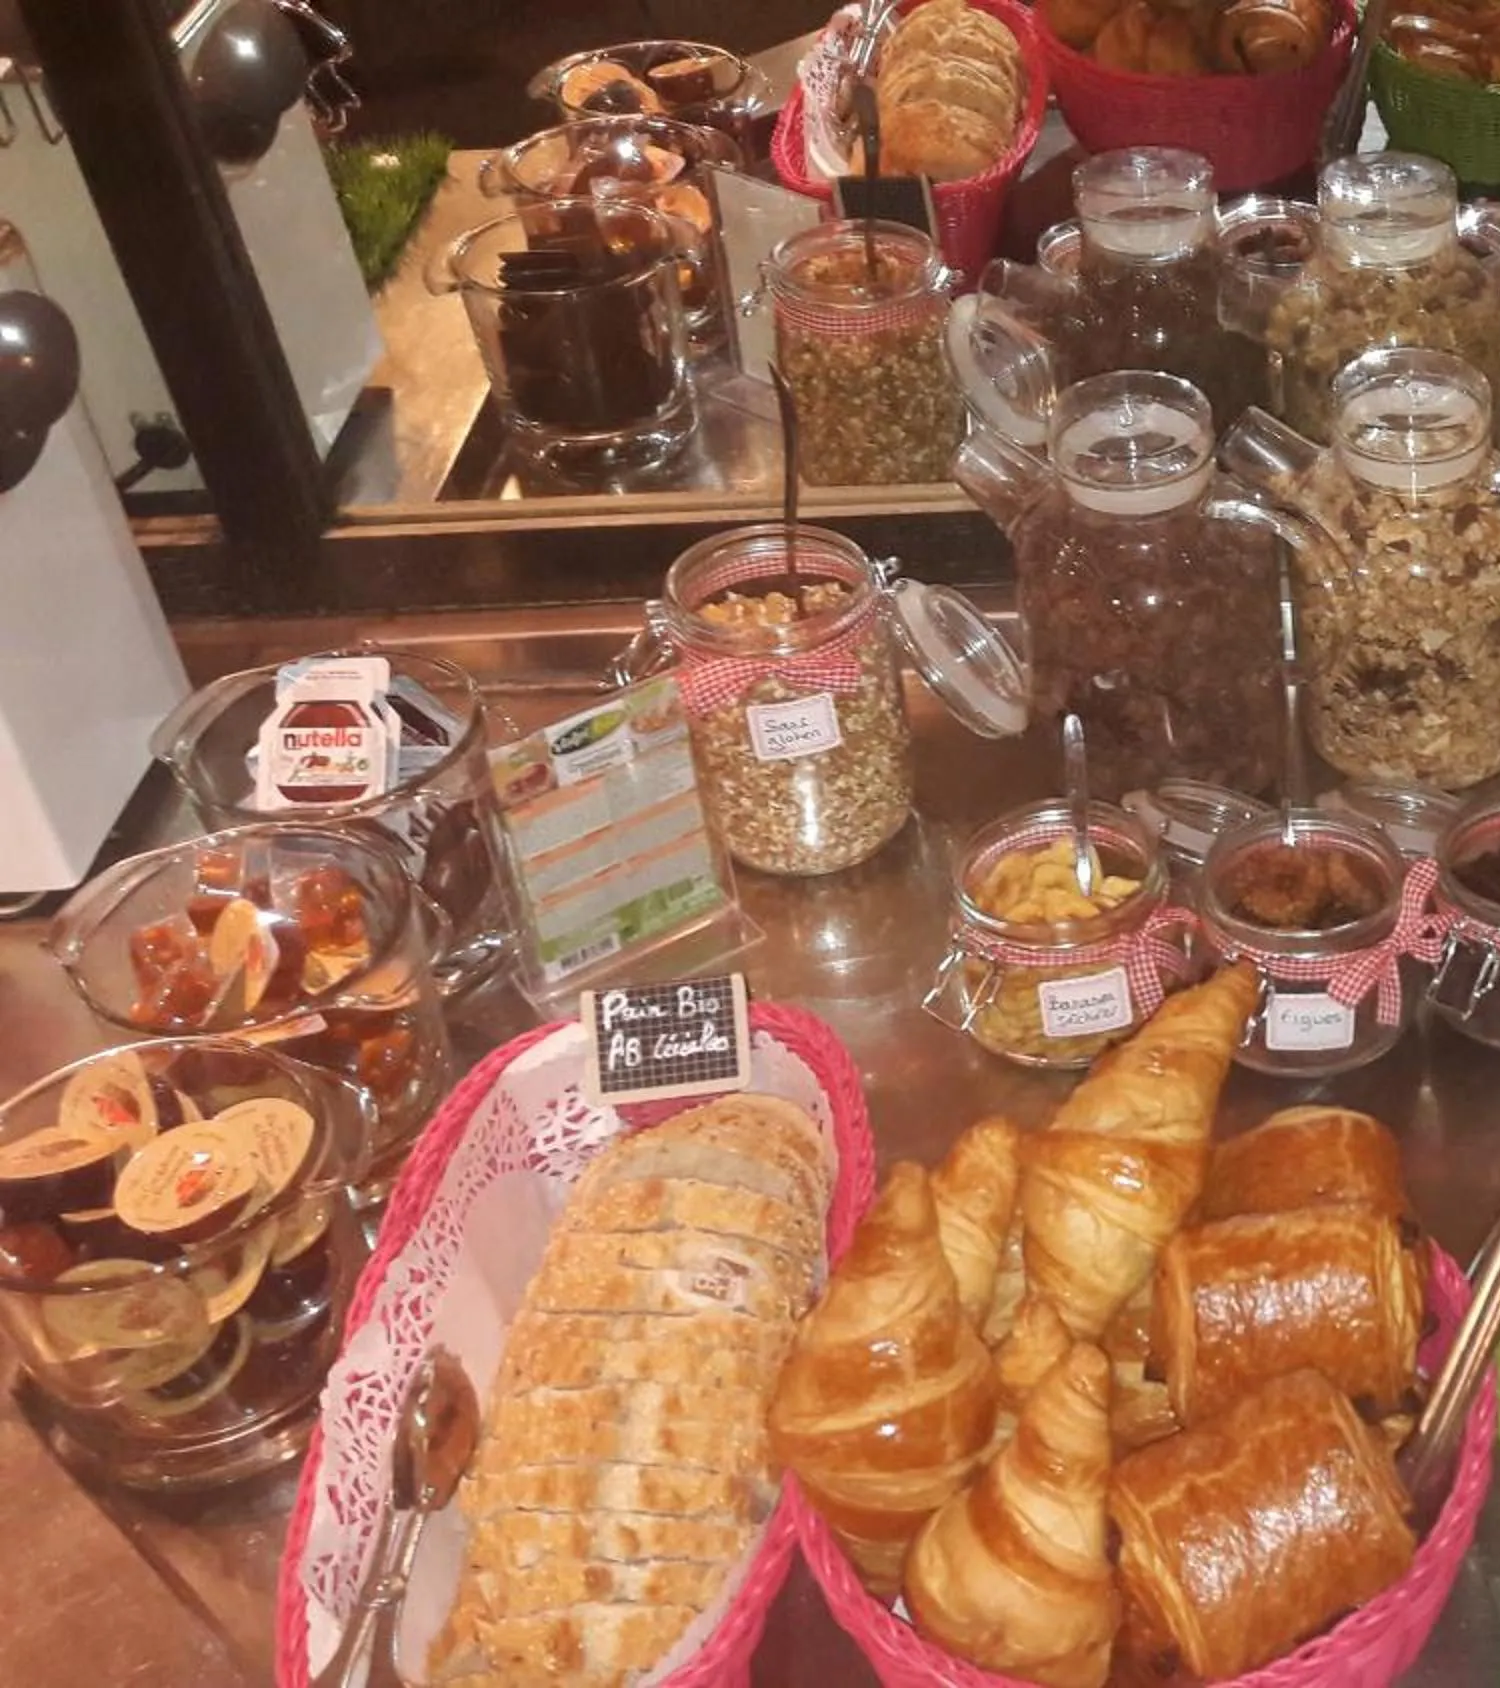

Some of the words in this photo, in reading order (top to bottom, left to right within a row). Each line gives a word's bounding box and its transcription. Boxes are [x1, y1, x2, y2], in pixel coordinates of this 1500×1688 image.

[283, 726, 361, 750] nutella
[603, 990, 669, 1031] Pain
[677, 985, 721, 1018] Bio
[608, 1030, 642, 1071] AB
